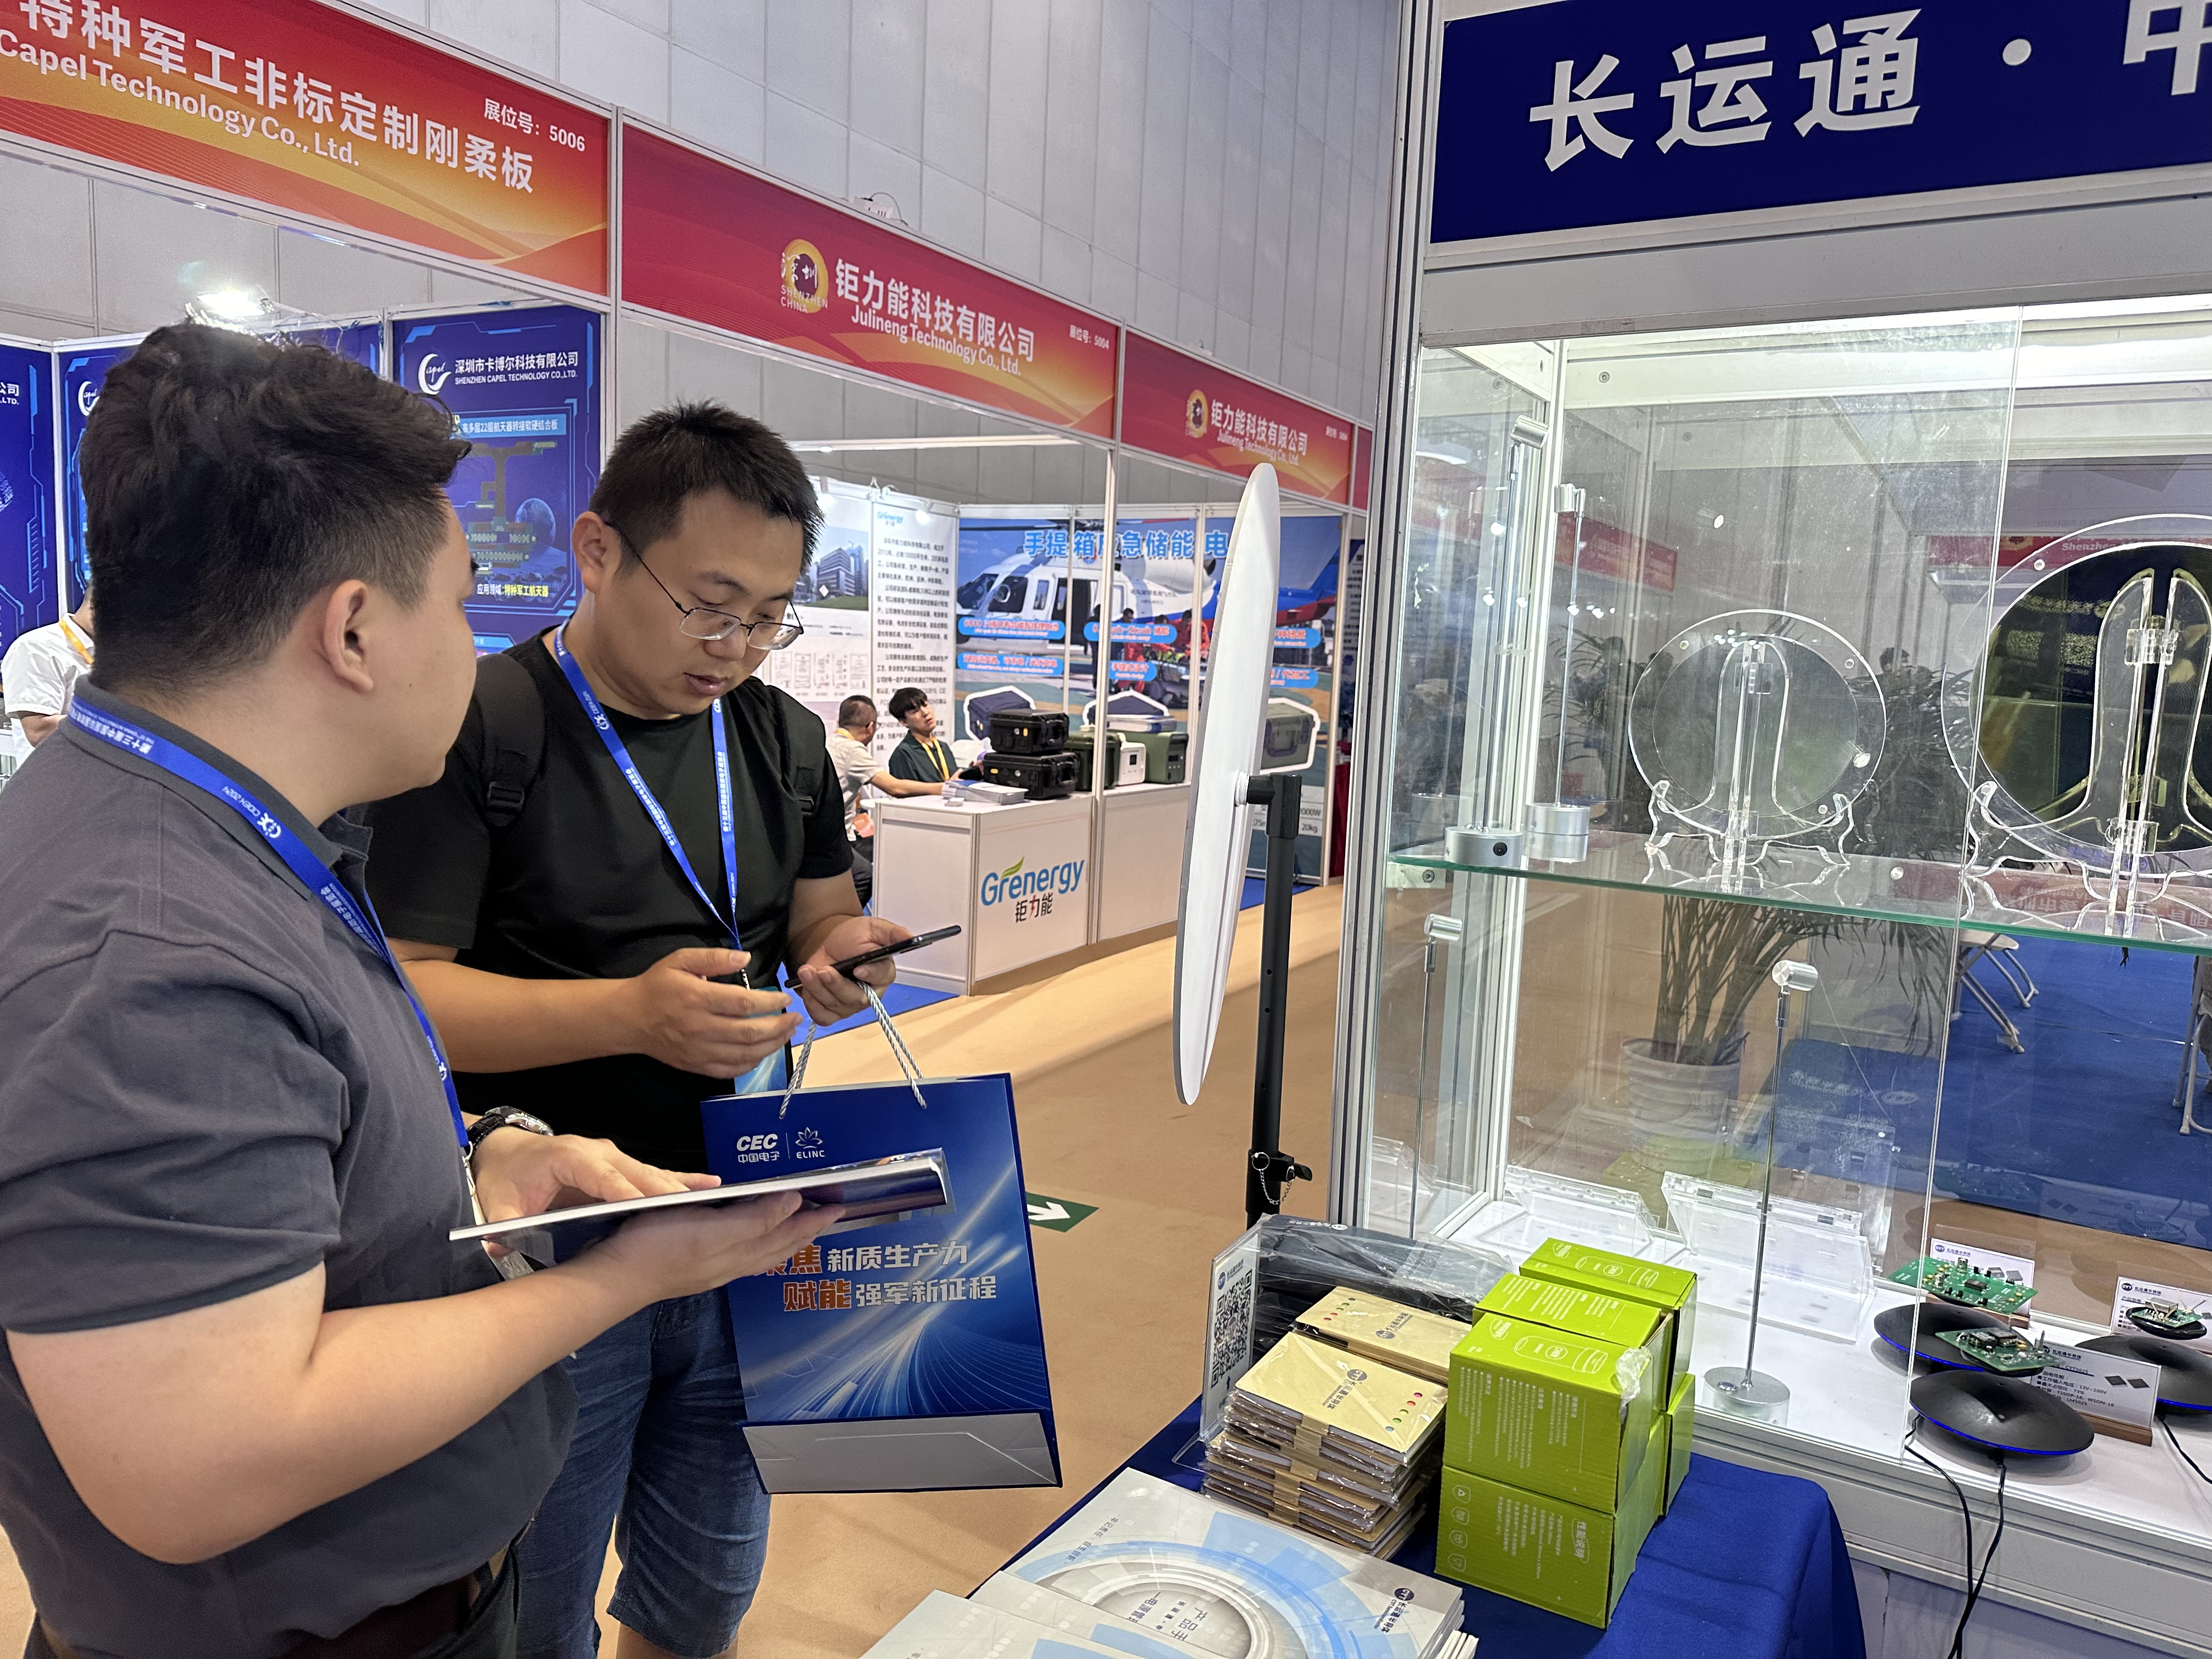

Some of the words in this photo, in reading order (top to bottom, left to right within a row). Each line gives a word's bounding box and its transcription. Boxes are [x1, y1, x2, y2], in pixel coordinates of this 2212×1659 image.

[0, 28, 86, 81] Capel
[92, 58, 256, 138] Technology
[261, 116, 309, 155] Co.,
[313, 136, 360, 168] Ltd.
[21, 0, 535, 194] 特种军工非标定制刚柔板
[549, 124, 586, 153] 5006
[781, 285, 828, 309] SHENZHEN
[781, 297, 808, 313] CHINA
[836, 258, 1035, 362] 钜力能科技有限公司
[851, 305, 907, 343] Julineng
[910, 321, 977, 363] Technology
[979, 347, 999, 371] Co.,
[1001, 355, 1021, 375] Ltd.
[455, 351, 578, 374] 深圳市卡博尔科技有限公司
[455, 375, 486, 385] SHENZHEN
[487, 374, 507, 383] CAPEL
[508, 371, 550, 382] TECHNOLOGY
[1211, 399, 1308, 456] 钜力能科技有限公司
[1024, 530, 1228, 558] 手提箱急储能电
[981, 859, 1085, 906] Grenergy
[1015, 893, 1053, 924] 钜力能
[736, 1133, 778, 1152] CEC
[737, 1151, 780, 1164] 中国电子
[796, 1149, 825, 1159] ELINC
[827, 1241, 968, 1273] 新质生产力
[783, 1279, 852, 1311] 赋能
[855, 1276, 997, 1308] 强军新征程
